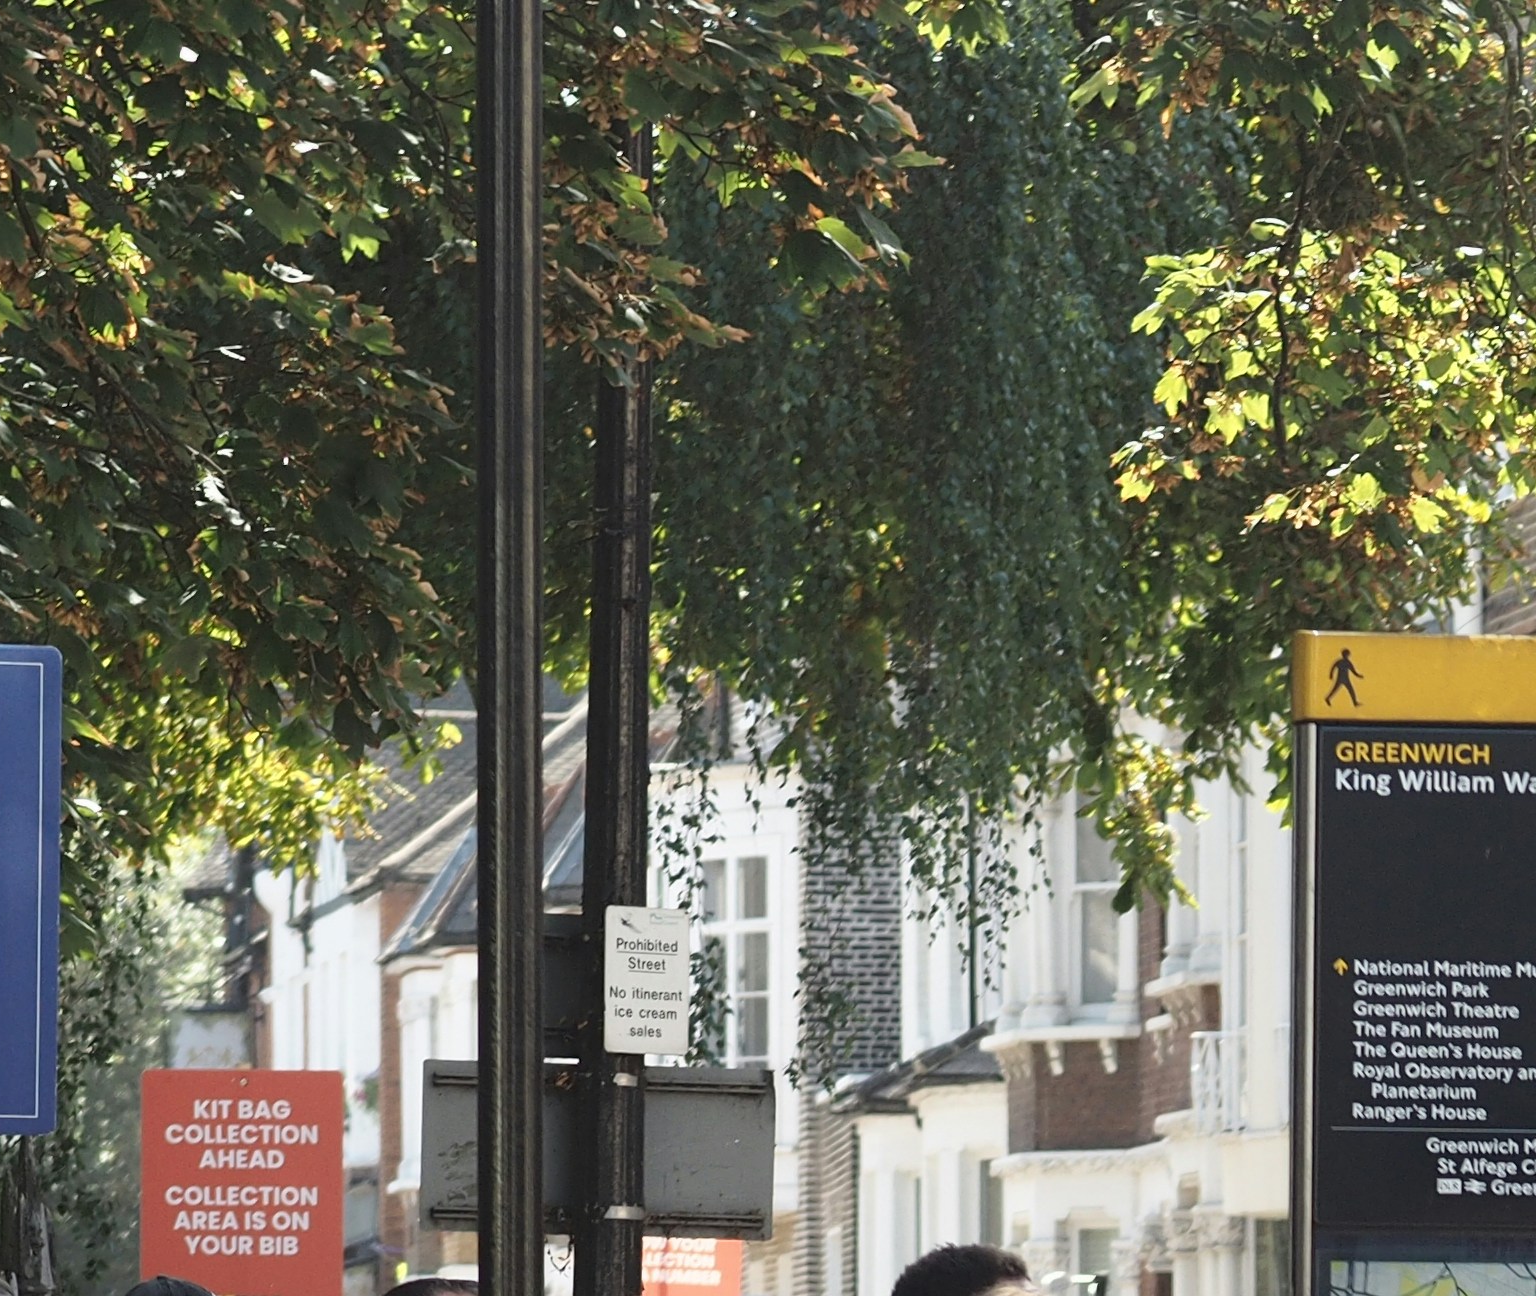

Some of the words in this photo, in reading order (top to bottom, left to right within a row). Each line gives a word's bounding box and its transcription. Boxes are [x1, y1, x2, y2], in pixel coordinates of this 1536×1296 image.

[1336, 742, 1489, 764] GREENWICH
[1336, 769, 1391, 796] King
[1398, 770, 1494, 792] William
[616, 938, 678, 952] Prohibited
[628, 957, 666, 970] Street
[1354, 960, 1430, 976] National
[1434, 961, 1511, 977] Maritime
[609, 986, 626, 999] No
[632, 987, 683, 1001] itinerant
[1354, 980, 1446, 996] Greenwich
[1452, 982, 1489, 997] Park
[614, 1005, 633, 1018] ice
[639, 1009, 677, 1019] cream
[1354, 1000, 1446, 1017] Greenwich
[1451, 1002, 1519, 1018] Theatre
[629, 1026, 662, 1038] sales
[1353, 1021, 1386, 1037] The
[1391, 1021, 1421, 1037] Fan
[1426, 1022, 1498, 1038] Museum
[1353, 1041, 1386, 1057] The
[1391, 1042, 1462, 1058] Queen's
[1467, 1043, 1522, 1059] House
[1353, 1062, 1401, 1081] Royal
[1405, 1063, 1513, 1083] Observatory
[1372, 1083, 1476, 1099] Planetarium
[194, 1100, 232, 1119] KIT
[238, 1100, 291, 1119] BAG
[1353, 1103, 1427, 1122] Ranger's
[1432, 1104, 1486, 1120] House
[165, 1124, 318, 1144] COLLECTION
[1426, 1137, 1519, 1154] Greenwich
[199, 1149, 284, 1168] AHEAD
[1438, 1158, 1456, 1174] St
[1461, 1158, 1517, 1177] Alfege
[166, 1186, 317, 1206] COLLECTION
[174, 1211, 238, 1230] AREA
[245, 1211, 266, 1230] IS
[272, 1211, 309, 1230] ON
[185, 1236, 253, 1254] YOUR
[260, 1236, 298, 1255] BIB
